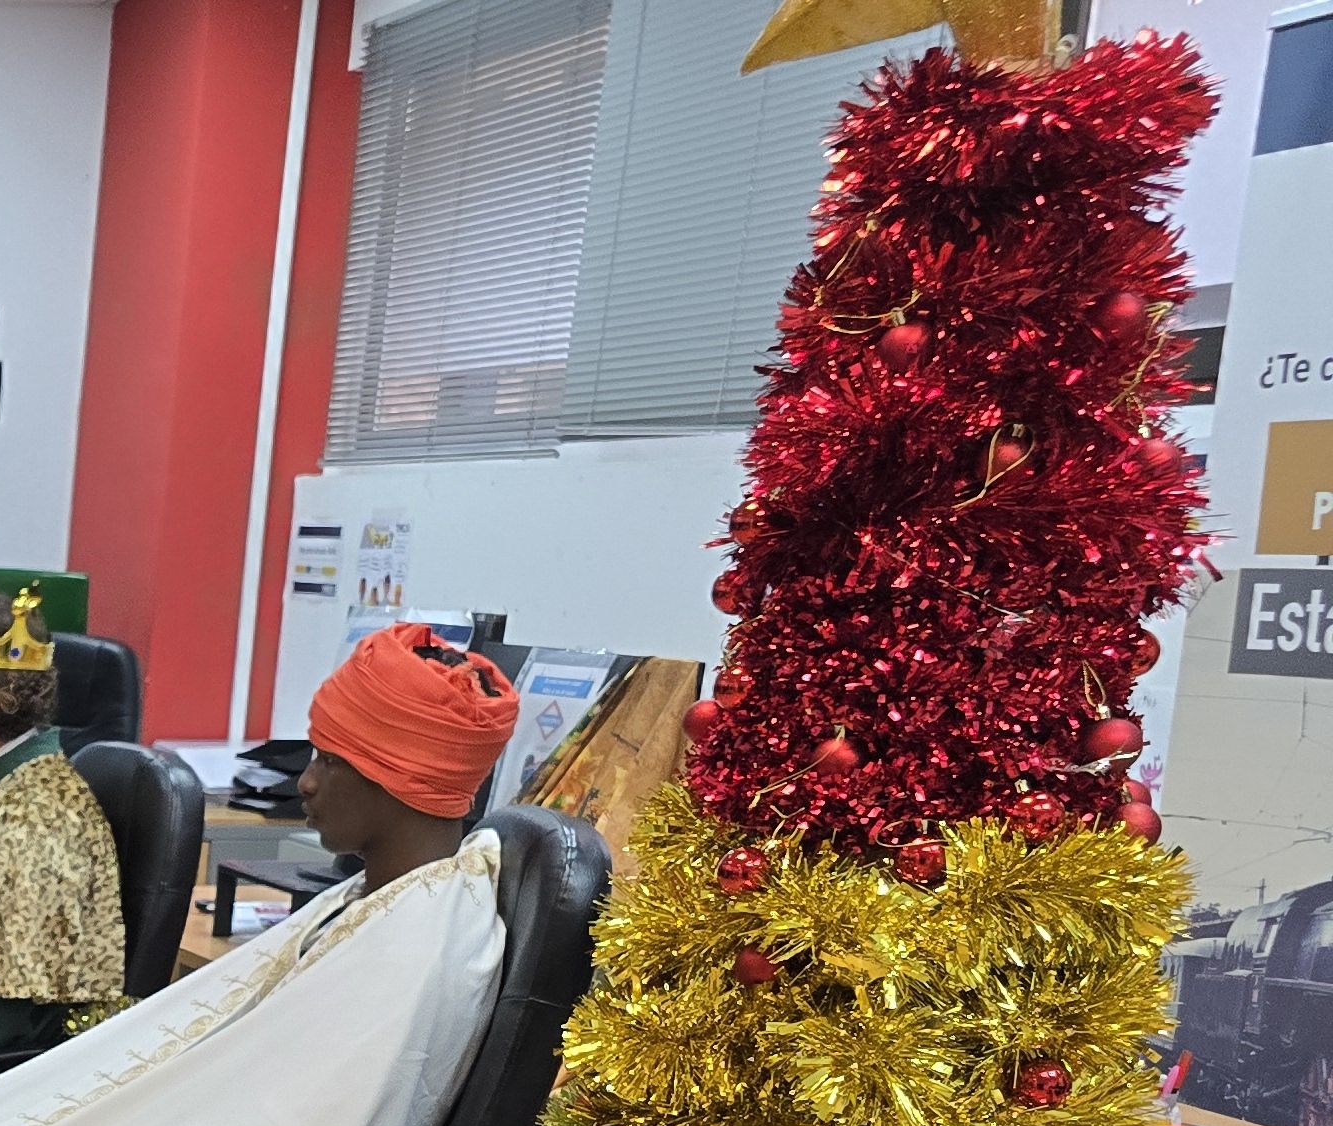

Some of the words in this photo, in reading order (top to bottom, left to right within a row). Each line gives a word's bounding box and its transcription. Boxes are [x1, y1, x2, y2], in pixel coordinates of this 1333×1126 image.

[1259, 352, 1311, 389] ¿Te
[1319, 356, 1333, 382] c
[1312, 490, 1333, 531] P
